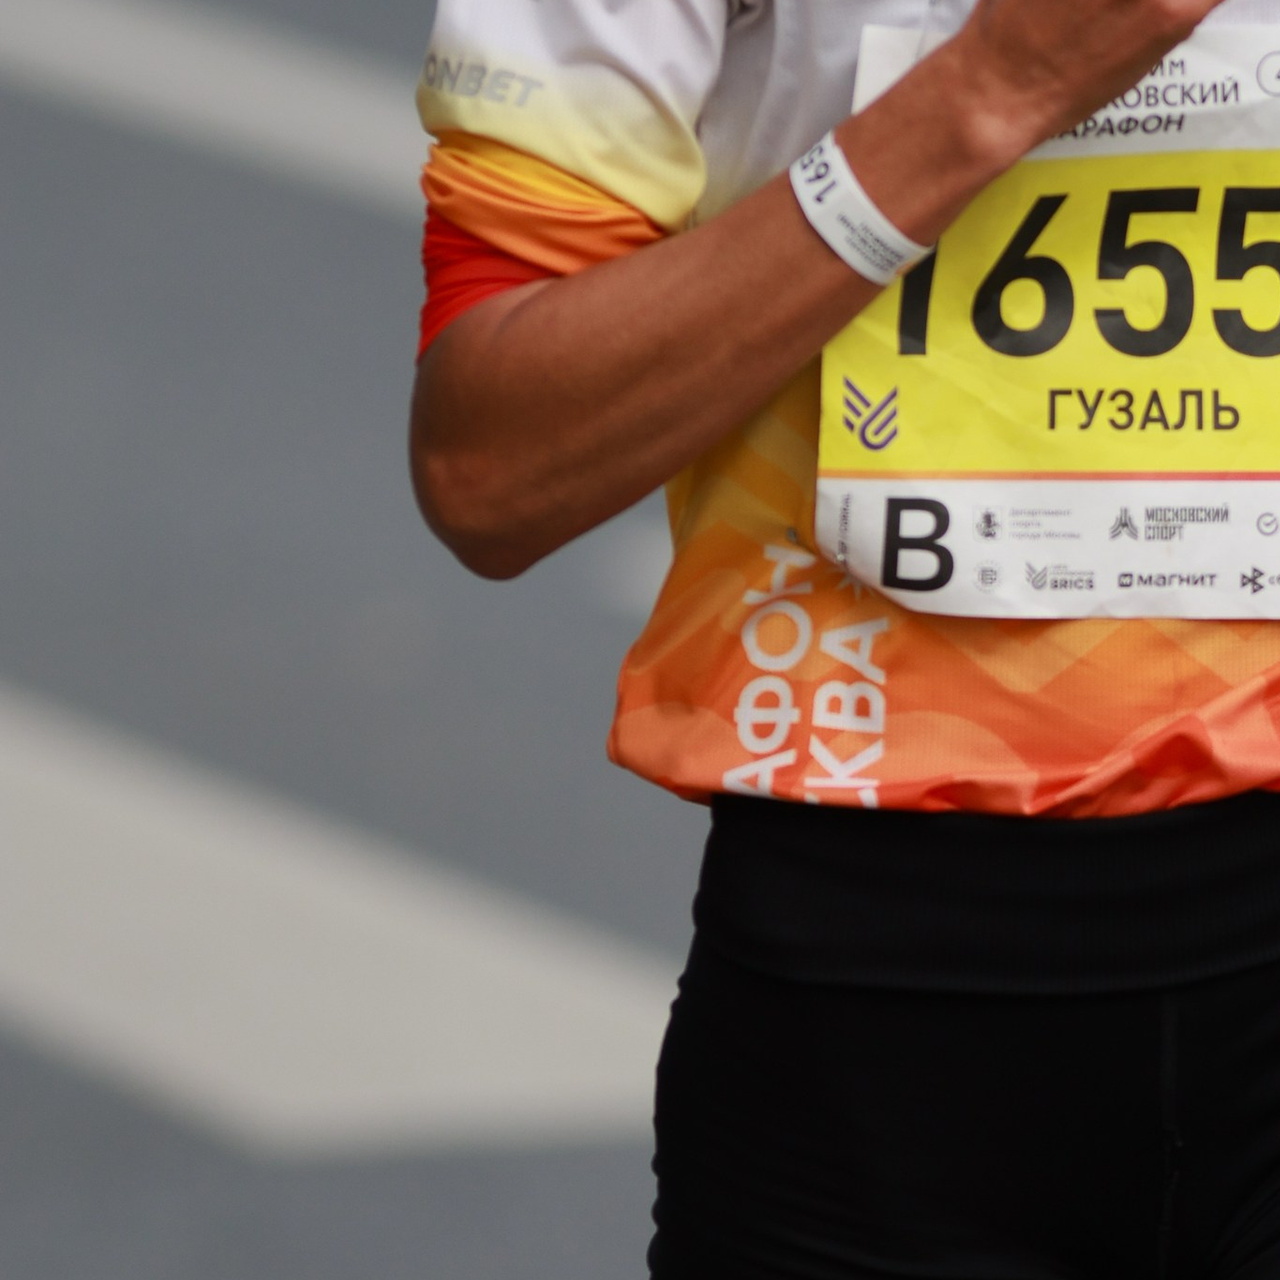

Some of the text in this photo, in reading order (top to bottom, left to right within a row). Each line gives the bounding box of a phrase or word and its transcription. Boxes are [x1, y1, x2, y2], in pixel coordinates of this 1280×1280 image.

[1047, 388, 1241, 432] ГУЗАЛЬ
[1145, 503, 1230, 523] МОСКОВСКИЙ
[1145, 524, 1184, 541] СПОРТ
[1049, 577, 1095, 592] BRICS
[803, 616, 890, 809] КВА
